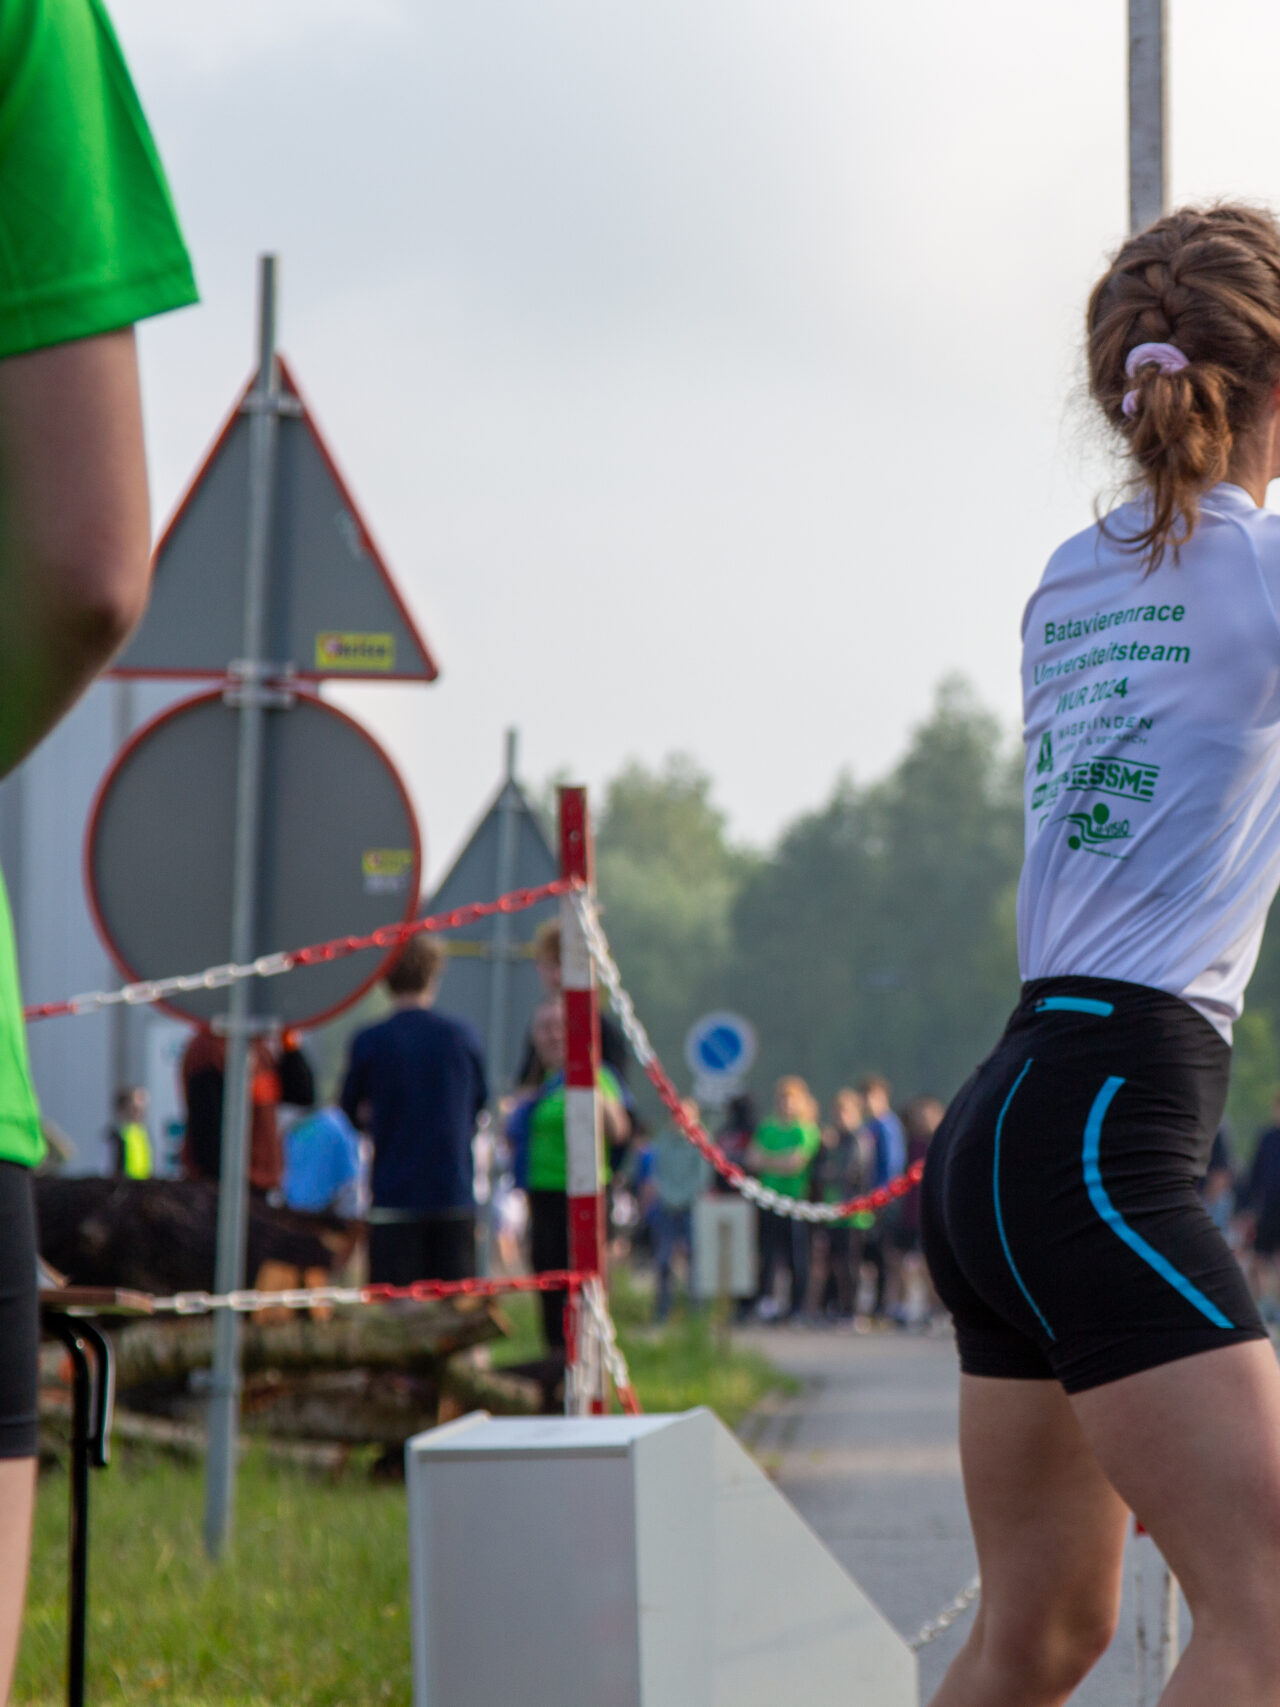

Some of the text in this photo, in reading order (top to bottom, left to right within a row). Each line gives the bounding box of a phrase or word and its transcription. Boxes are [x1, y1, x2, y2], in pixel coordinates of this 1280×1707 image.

[1044, 604, 1186, 645] Batavierenrace
[1034, 641, 1191, 686] Universiteitsteam
[1056, 677, 1129, 715] WUR 2024
